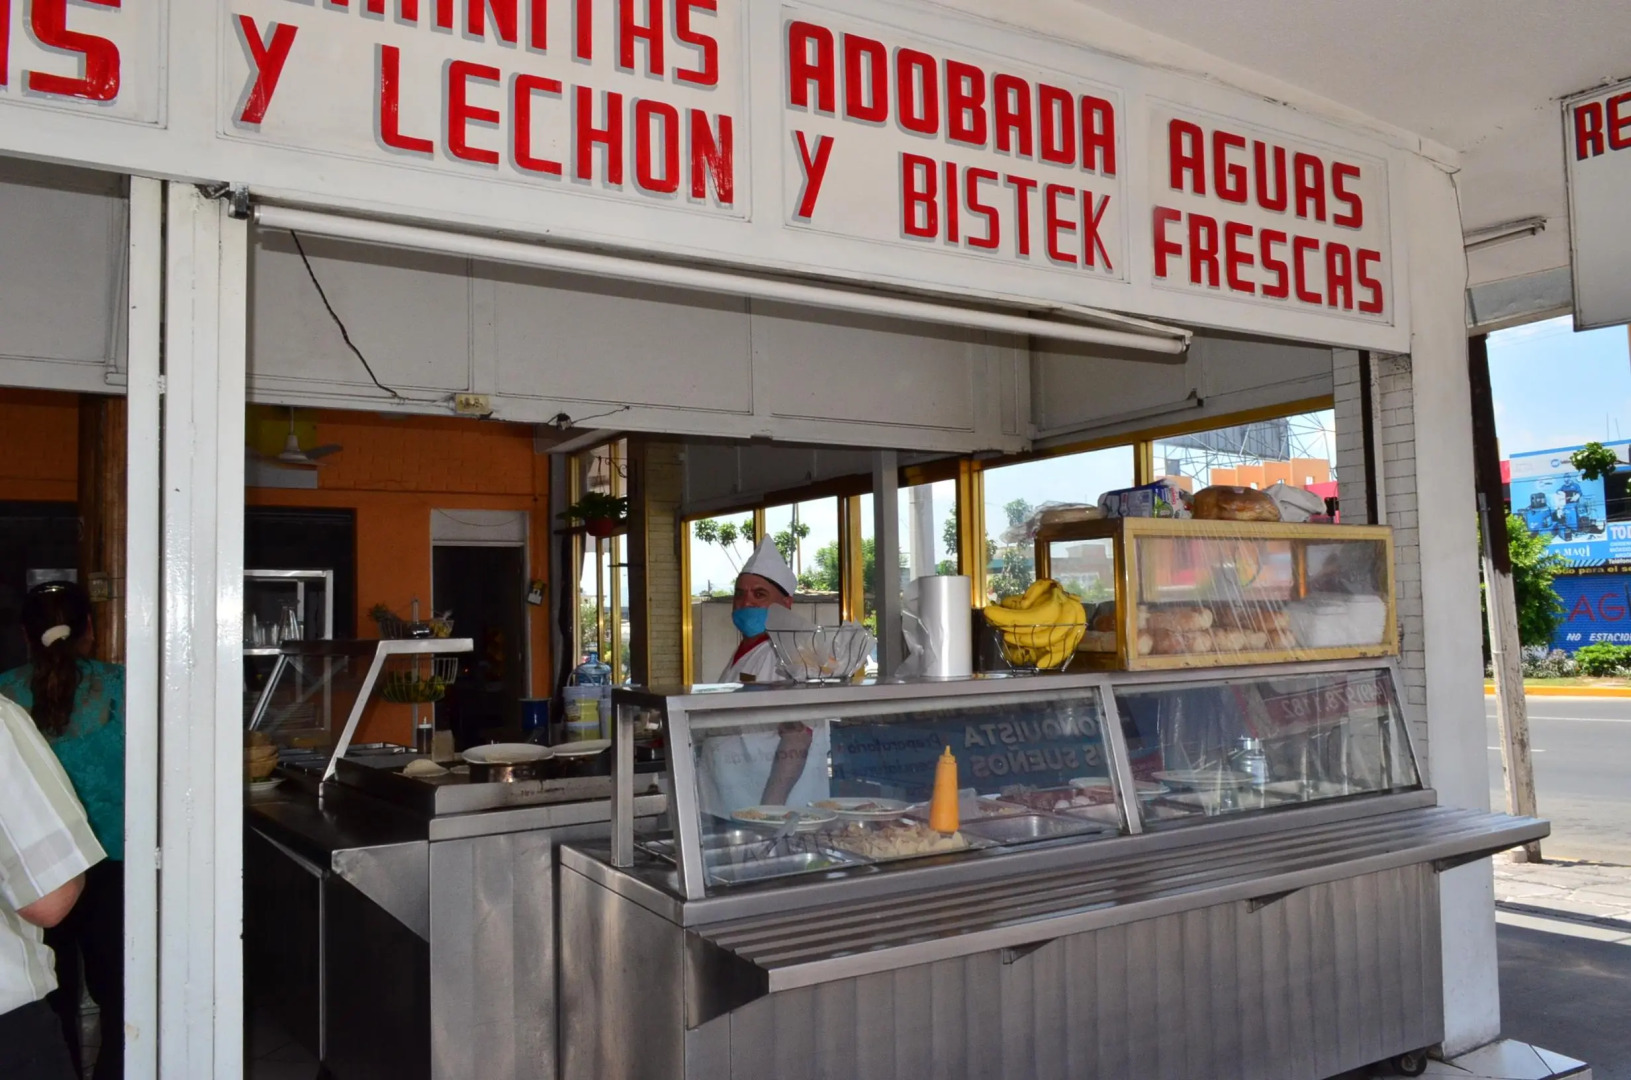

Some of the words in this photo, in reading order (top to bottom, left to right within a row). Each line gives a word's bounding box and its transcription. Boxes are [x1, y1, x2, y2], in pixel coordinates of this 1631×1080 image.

[238, 15, 297, 123] Y
[378, 45, 733, 203] LECHON
[787, 21, 1117, 174] ADOBADA
[1574, 91, 1631, 161] RE
[794, 130, 835, 219] Y
[901, 151, 1113, 270] BISTEK
[1168, 119, 1363, 229] AGUAS
[1152, 206, 1384, 314] FRESCAS
[1566, 632, 1582, 641] NO
